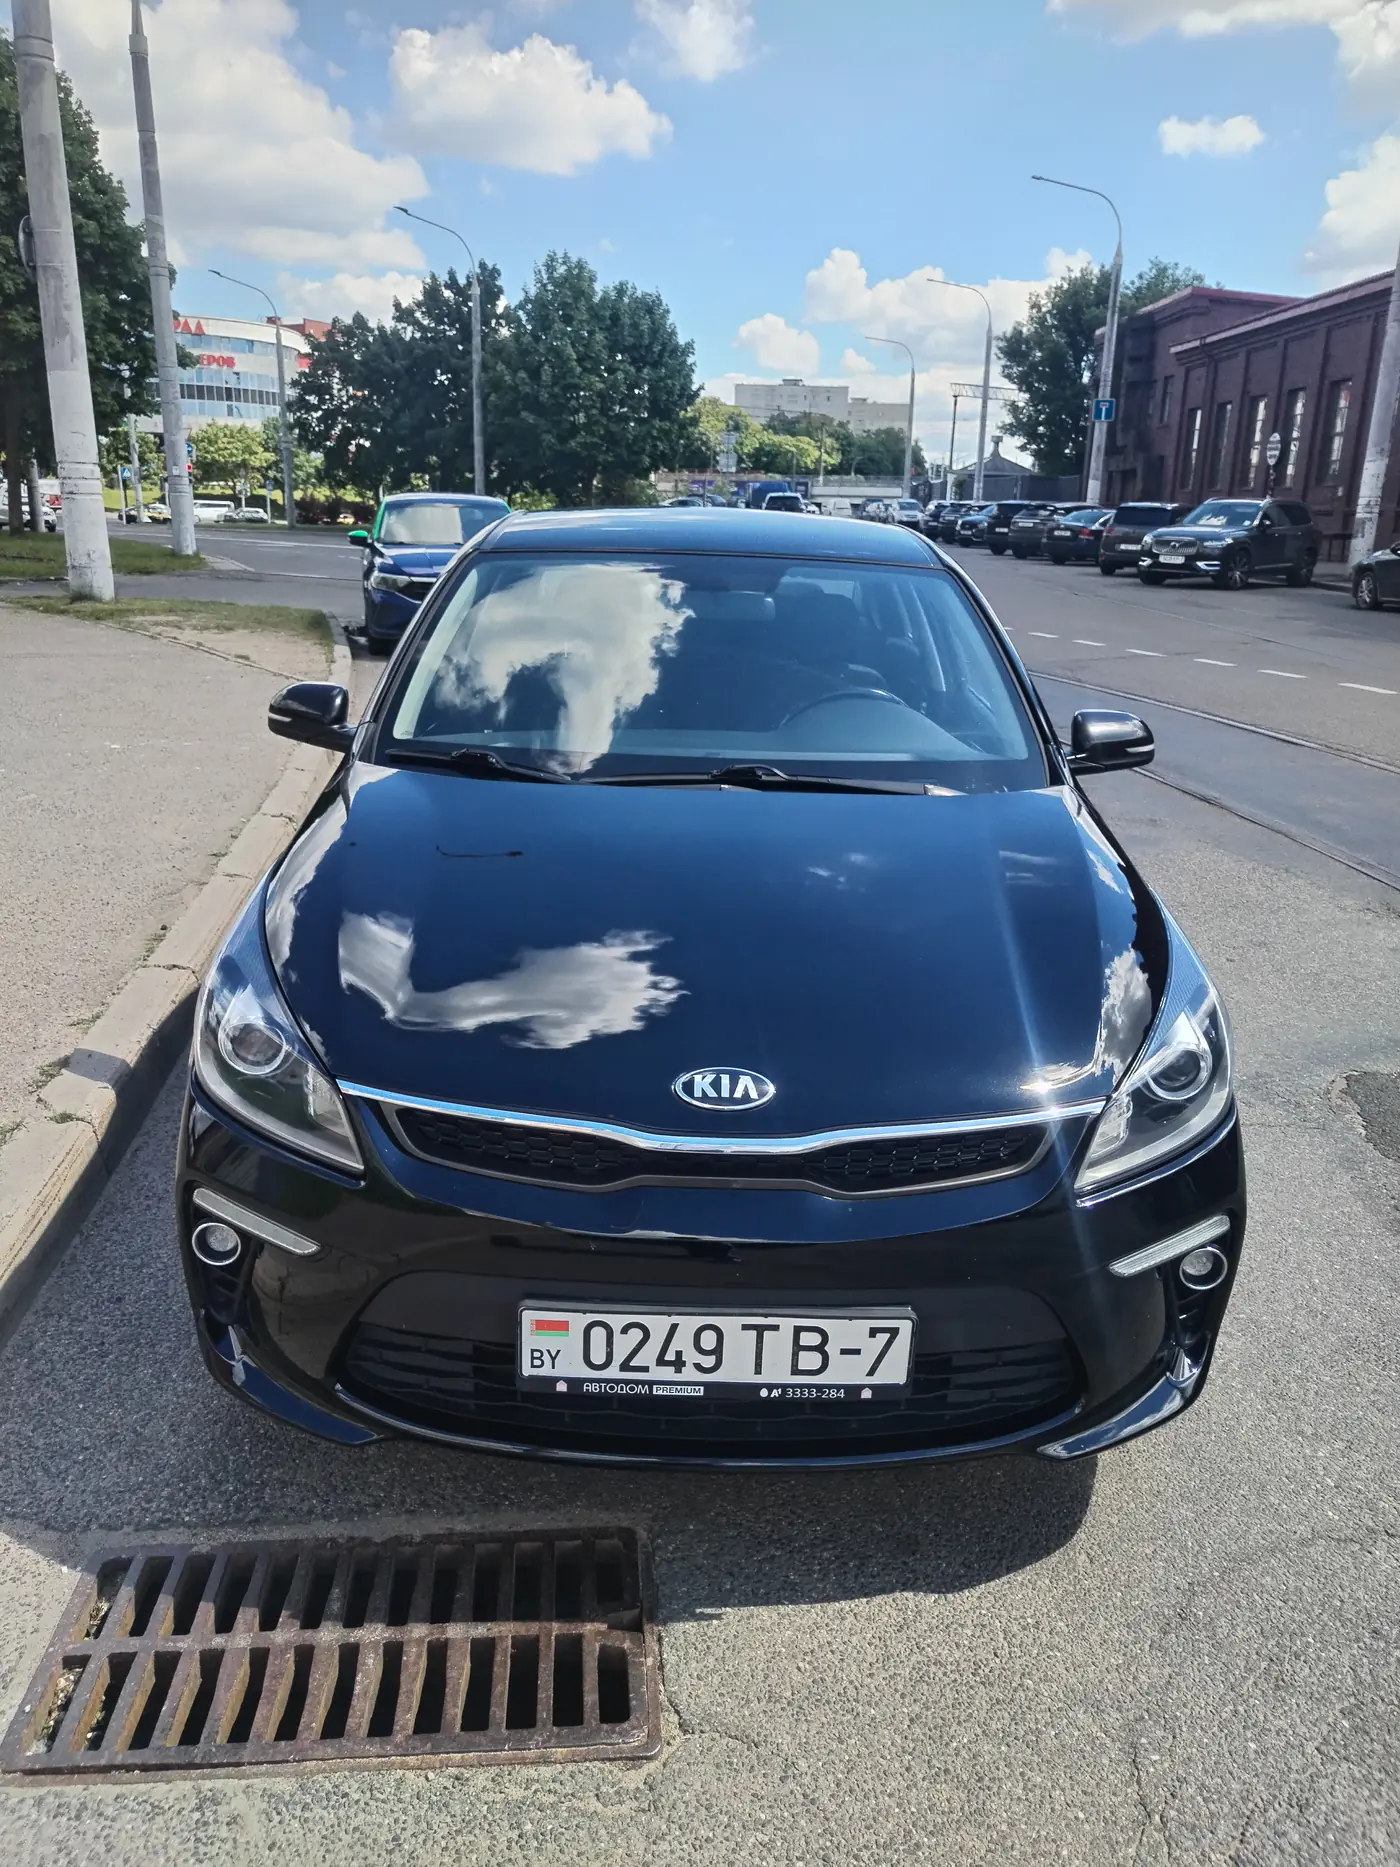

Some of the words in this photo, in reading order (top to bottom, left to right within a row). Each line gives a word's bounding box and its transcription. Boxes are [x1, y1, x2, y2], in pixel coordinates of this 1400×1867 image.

[693, 1074, 759, 1099] KIA
[530, 1348, 561, 1369] BY
[582, 1319, 725, 1375] 0249
[741, 1323, 900, 1377] TB-7
[583, 1382, 649, 1394] АВТОДОМ
[655, 1386, 701, 1395] PREMIUM
[785, 1388, 845, 1399] 3333-284
